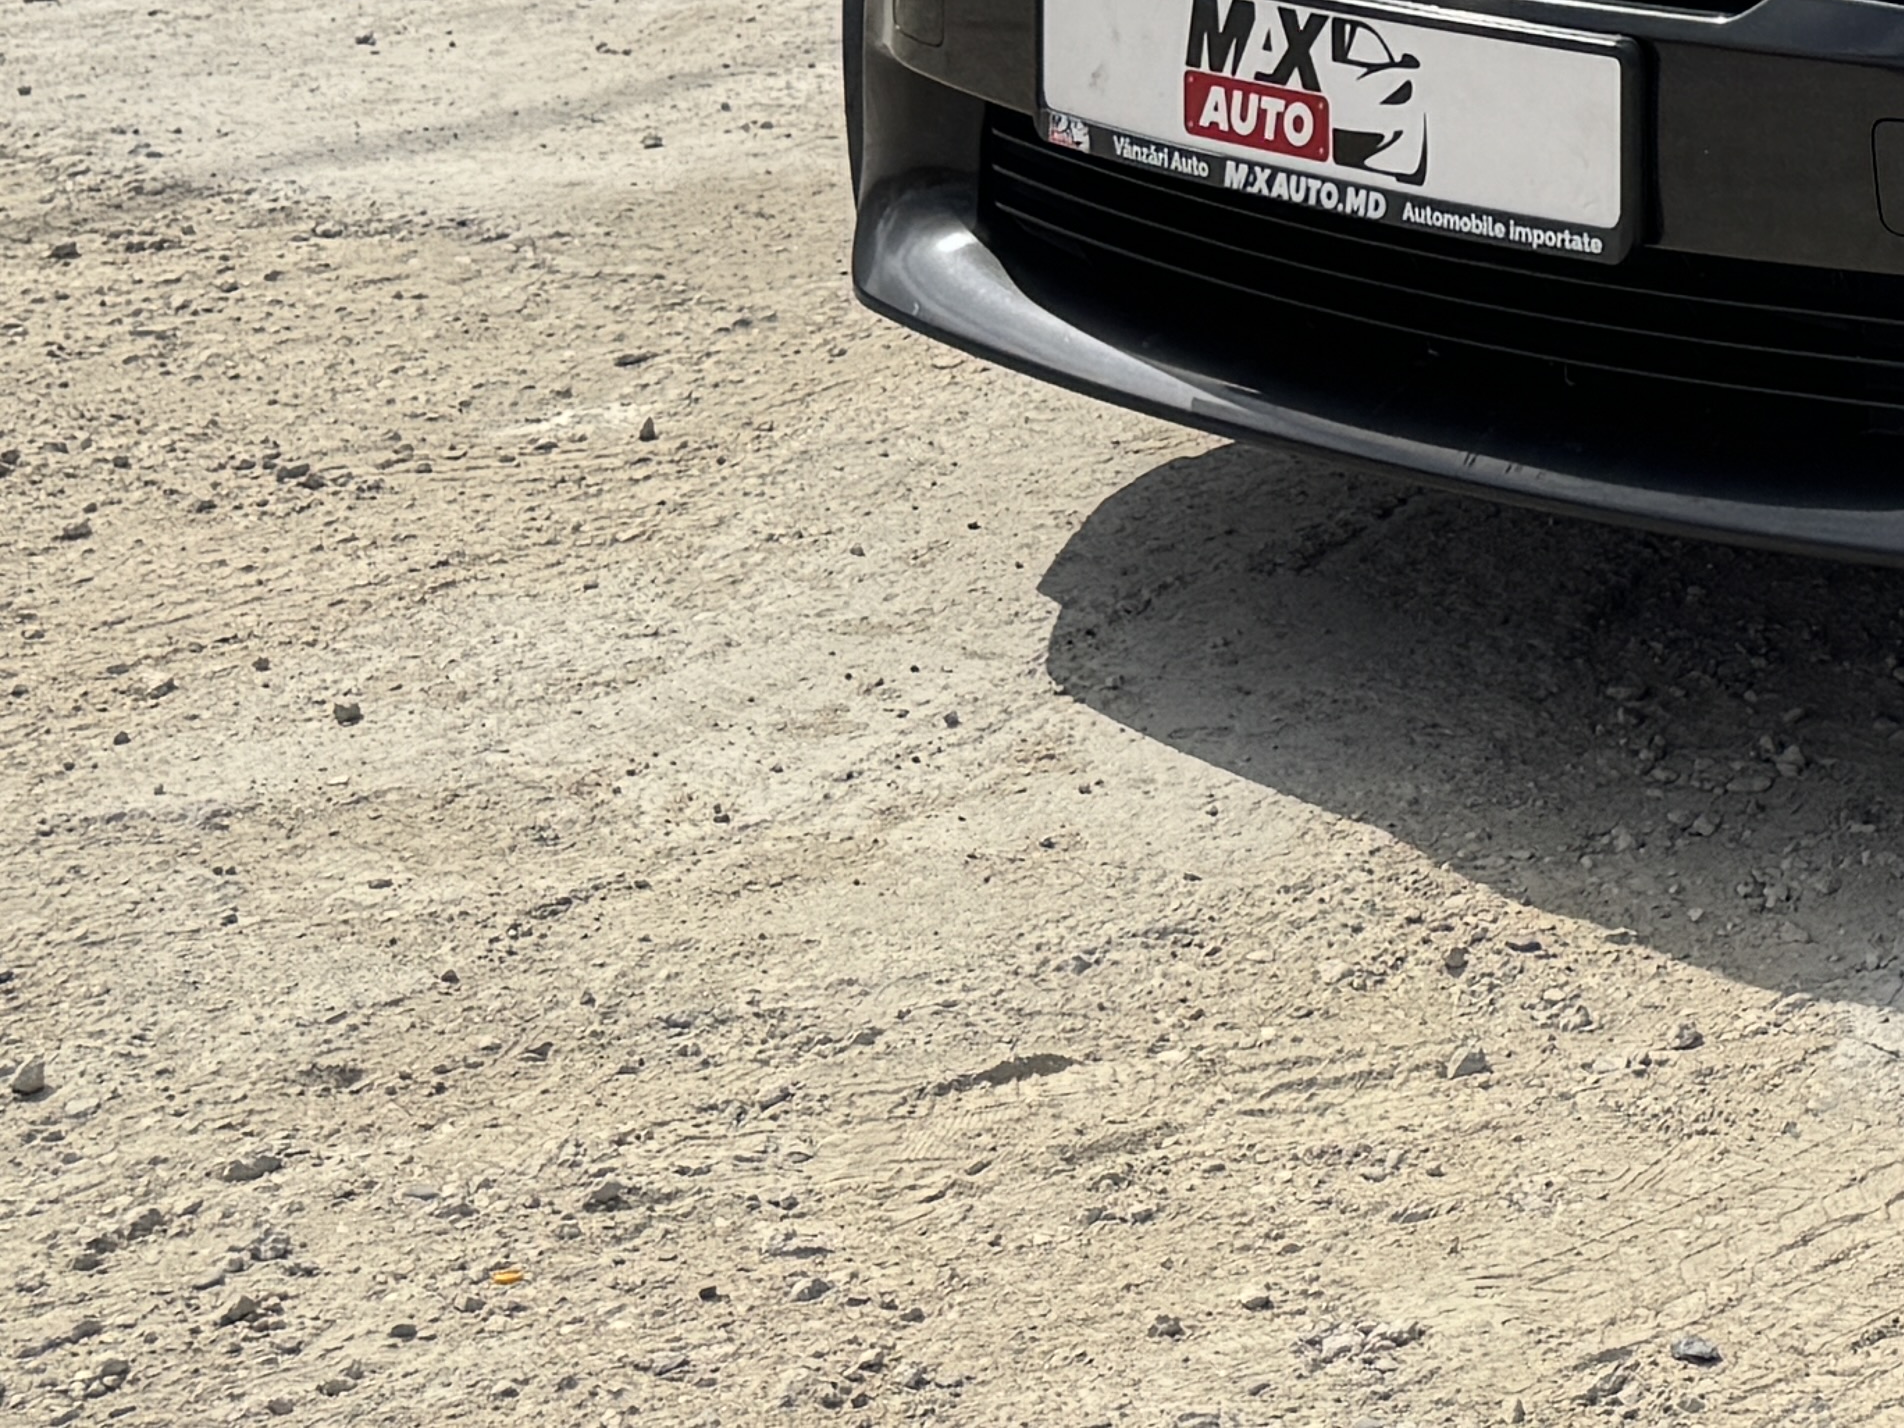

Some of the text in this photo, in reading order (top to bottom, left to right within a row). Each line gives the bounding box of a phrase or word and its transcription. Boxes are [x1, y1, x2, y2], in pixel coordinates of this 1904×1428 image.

[1199, 85, 1314, 147] AUTO
[1171, 150, 1209, 178] Auto
[1402, 200, 1506, 239] Automobile
[1508, 219, 1603, 255] importate
